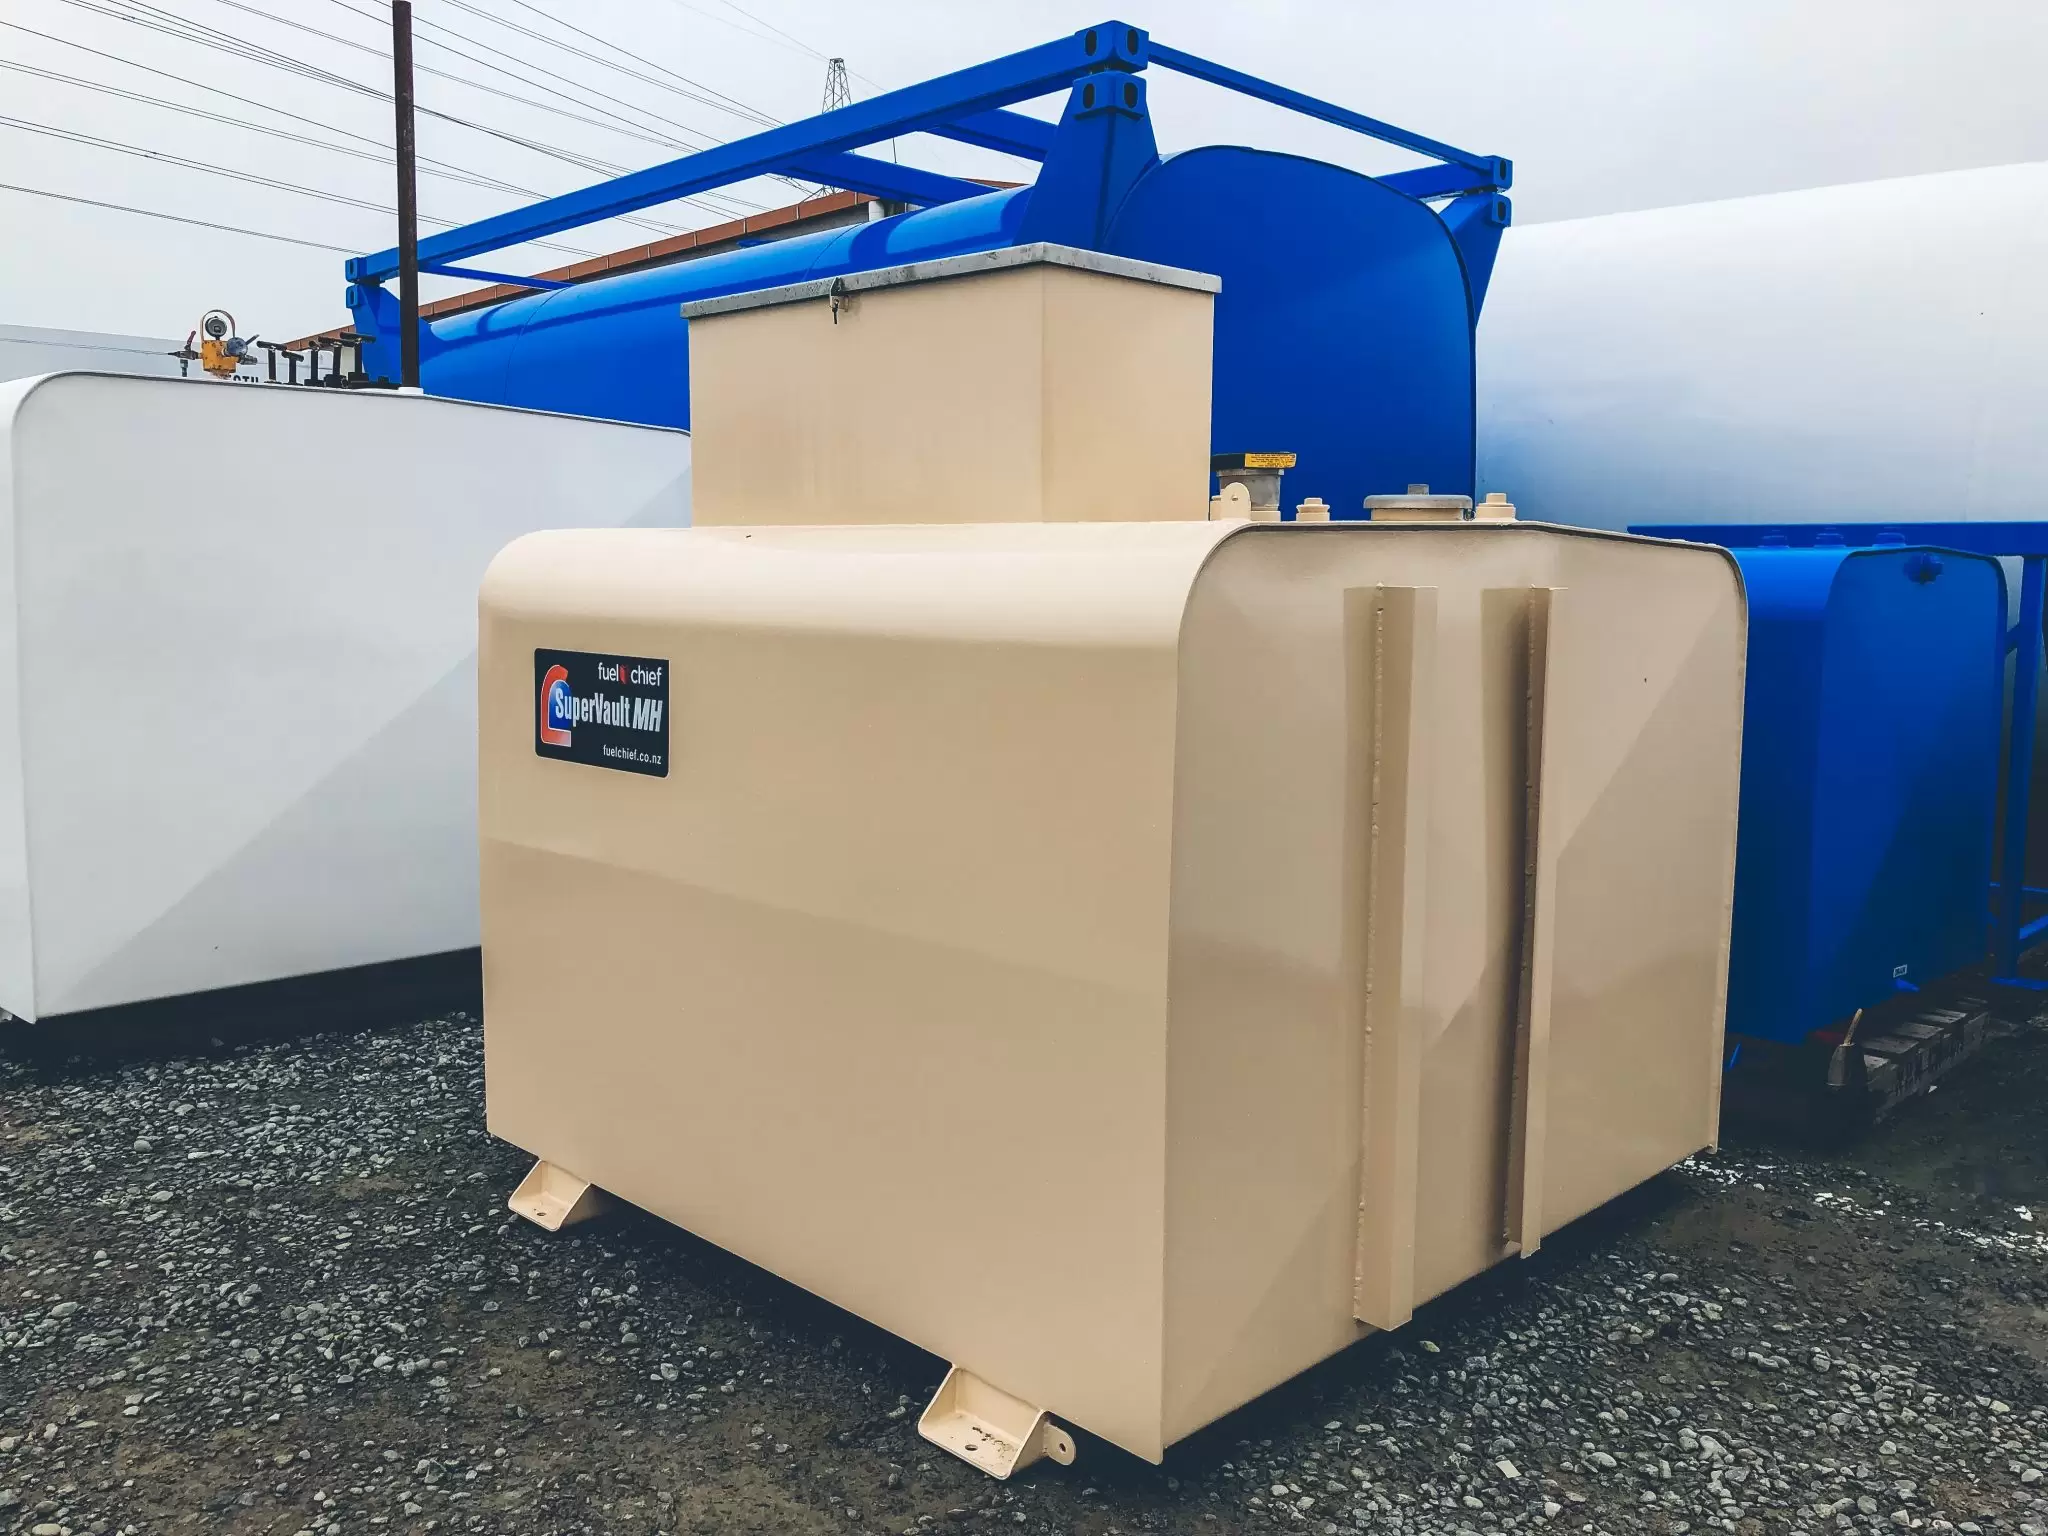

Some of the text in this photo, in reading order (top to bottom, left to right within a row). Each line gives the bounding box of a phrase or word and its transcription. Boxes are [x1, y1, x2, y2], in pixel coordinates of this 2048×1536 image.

[598, 662, 662, 687] fuel chief
[555, 688, 663, 732] SuperVault MH
[603, 744, 662, 765] fuelchief.co.nz
